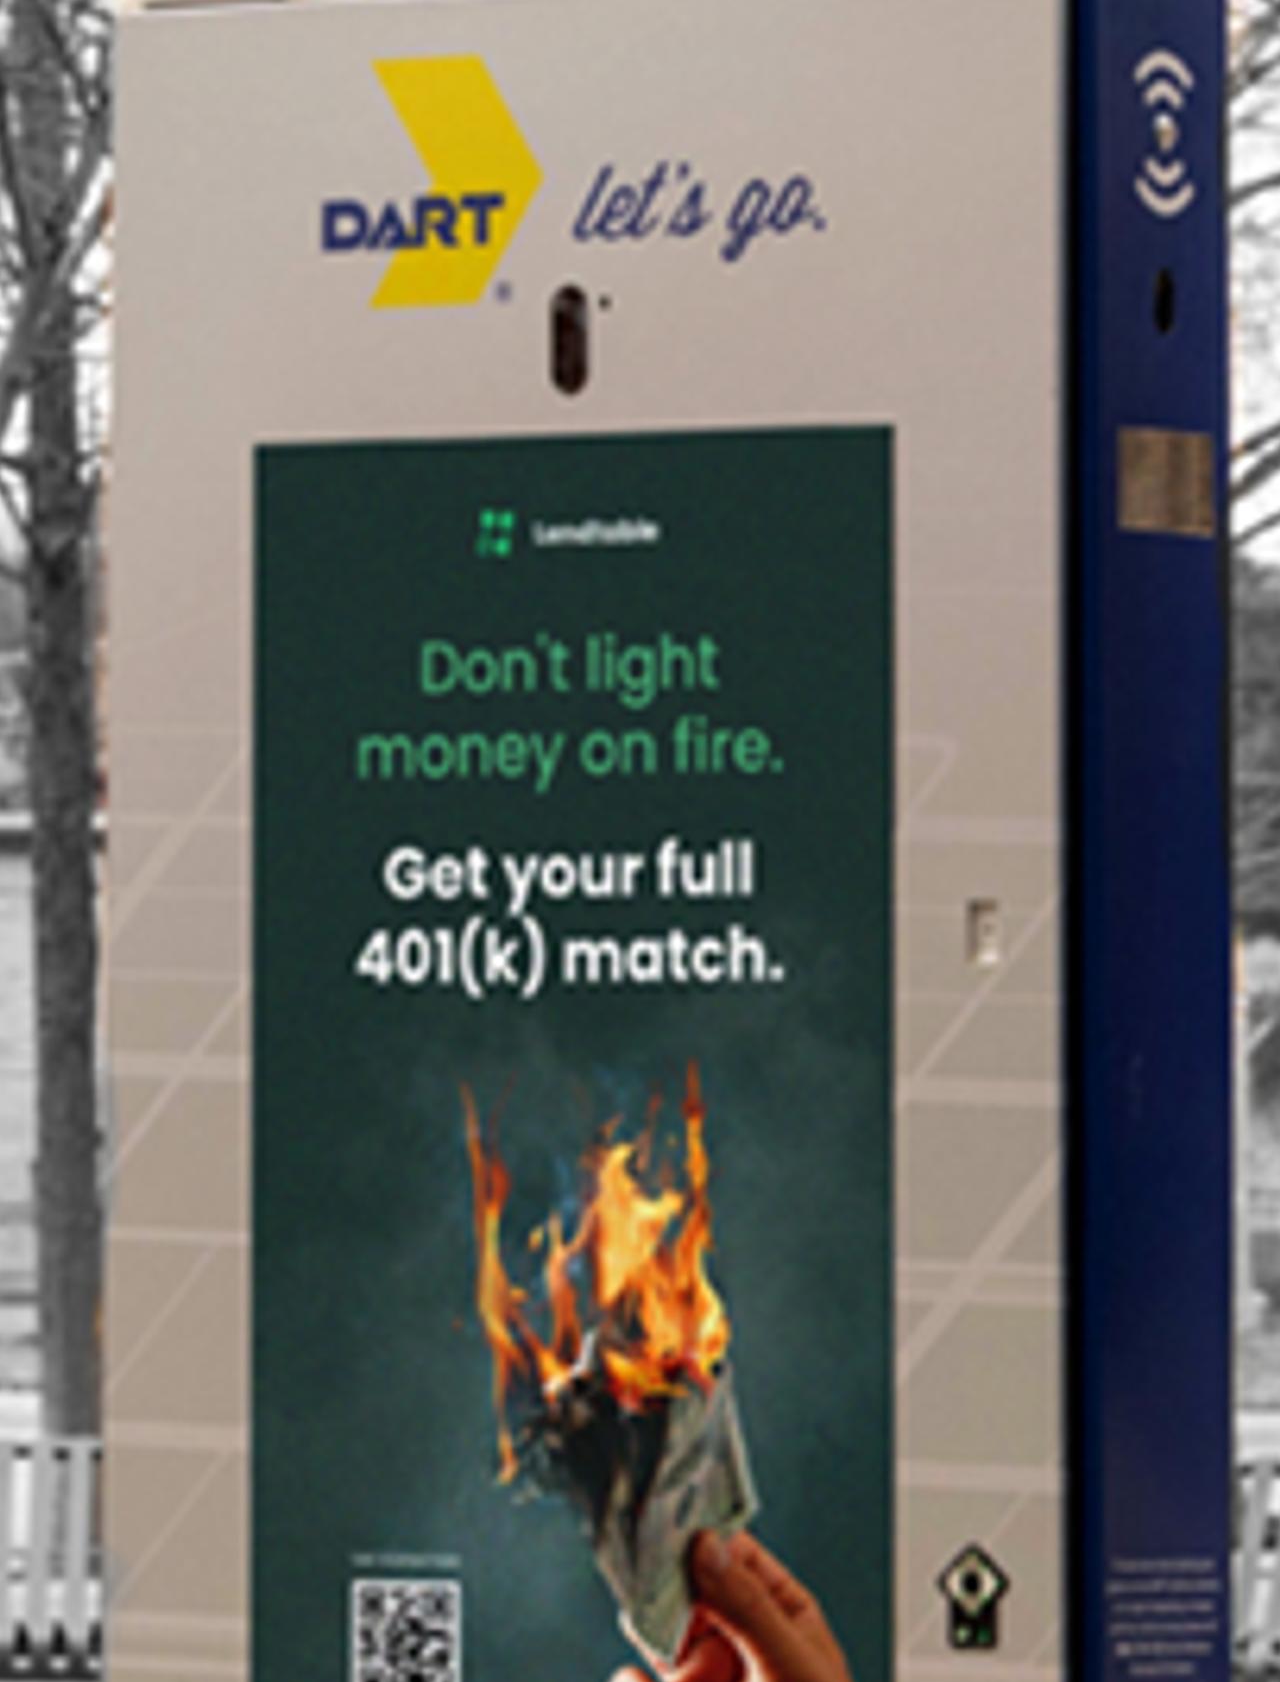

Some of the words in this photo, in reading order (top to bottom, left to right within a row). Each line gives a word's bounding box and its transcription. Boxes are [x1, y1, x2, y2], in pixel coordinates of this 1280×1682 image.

[322, 191, 505, 251] DART
[572, 159, 713, 243] let's
[719, 173, 827, 264] go.
[419, 632, 572, 694] Don't
[585, 632, 719, 710] light
[355, 729, 565, 794] money
[578, 729, 657, 776] on
[672, 716, 785, 775] fire.
[382, 846, 490, 899] Get
[502, 850, 644, 917] your
[655, 838, 755, 897] full
[354, 915, 546, 1000] 401(k)
[561, 923, 786, 983] match.
